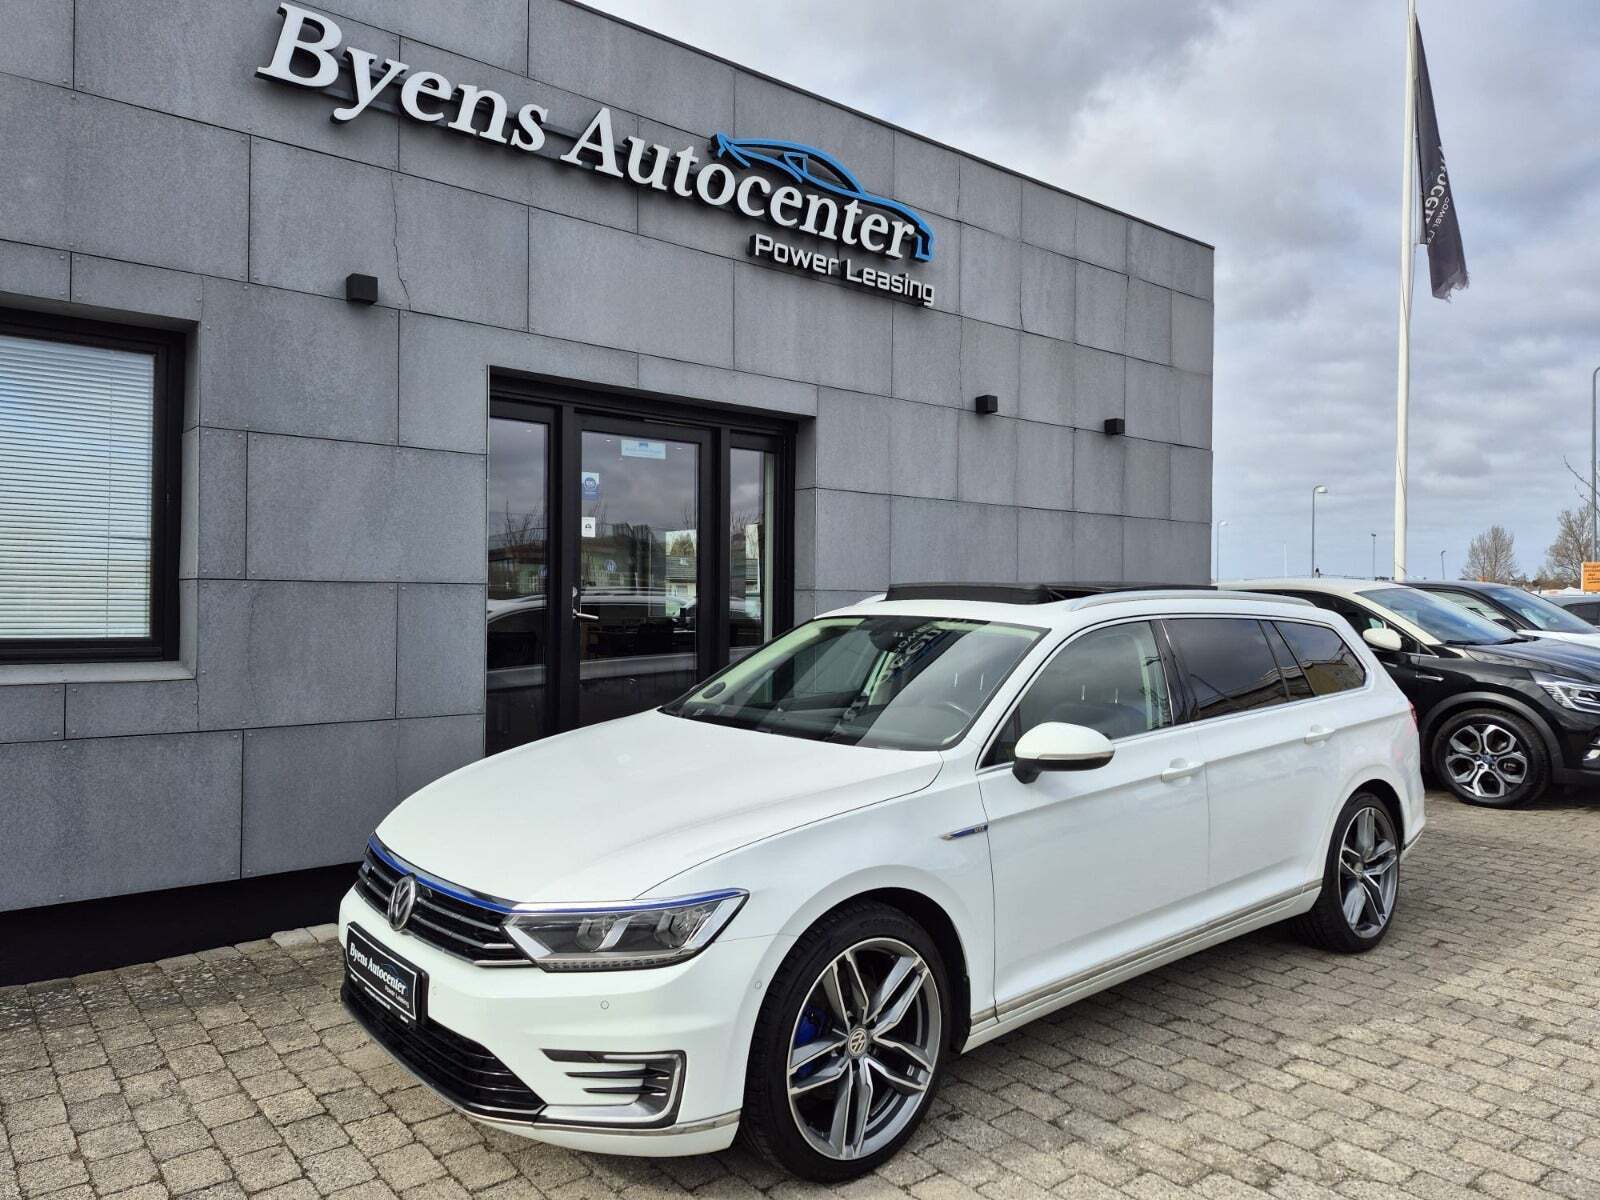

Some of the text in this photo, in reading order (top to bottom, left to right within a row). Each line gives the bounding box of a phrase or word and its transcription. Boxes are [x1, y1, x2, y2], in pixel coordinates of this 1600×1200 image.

[255, 2, 915, 258] Byens Autocenter
[753, 232, 935, 306] Power Leasing
[350, 942, 407, 995] Byens Autocenter
